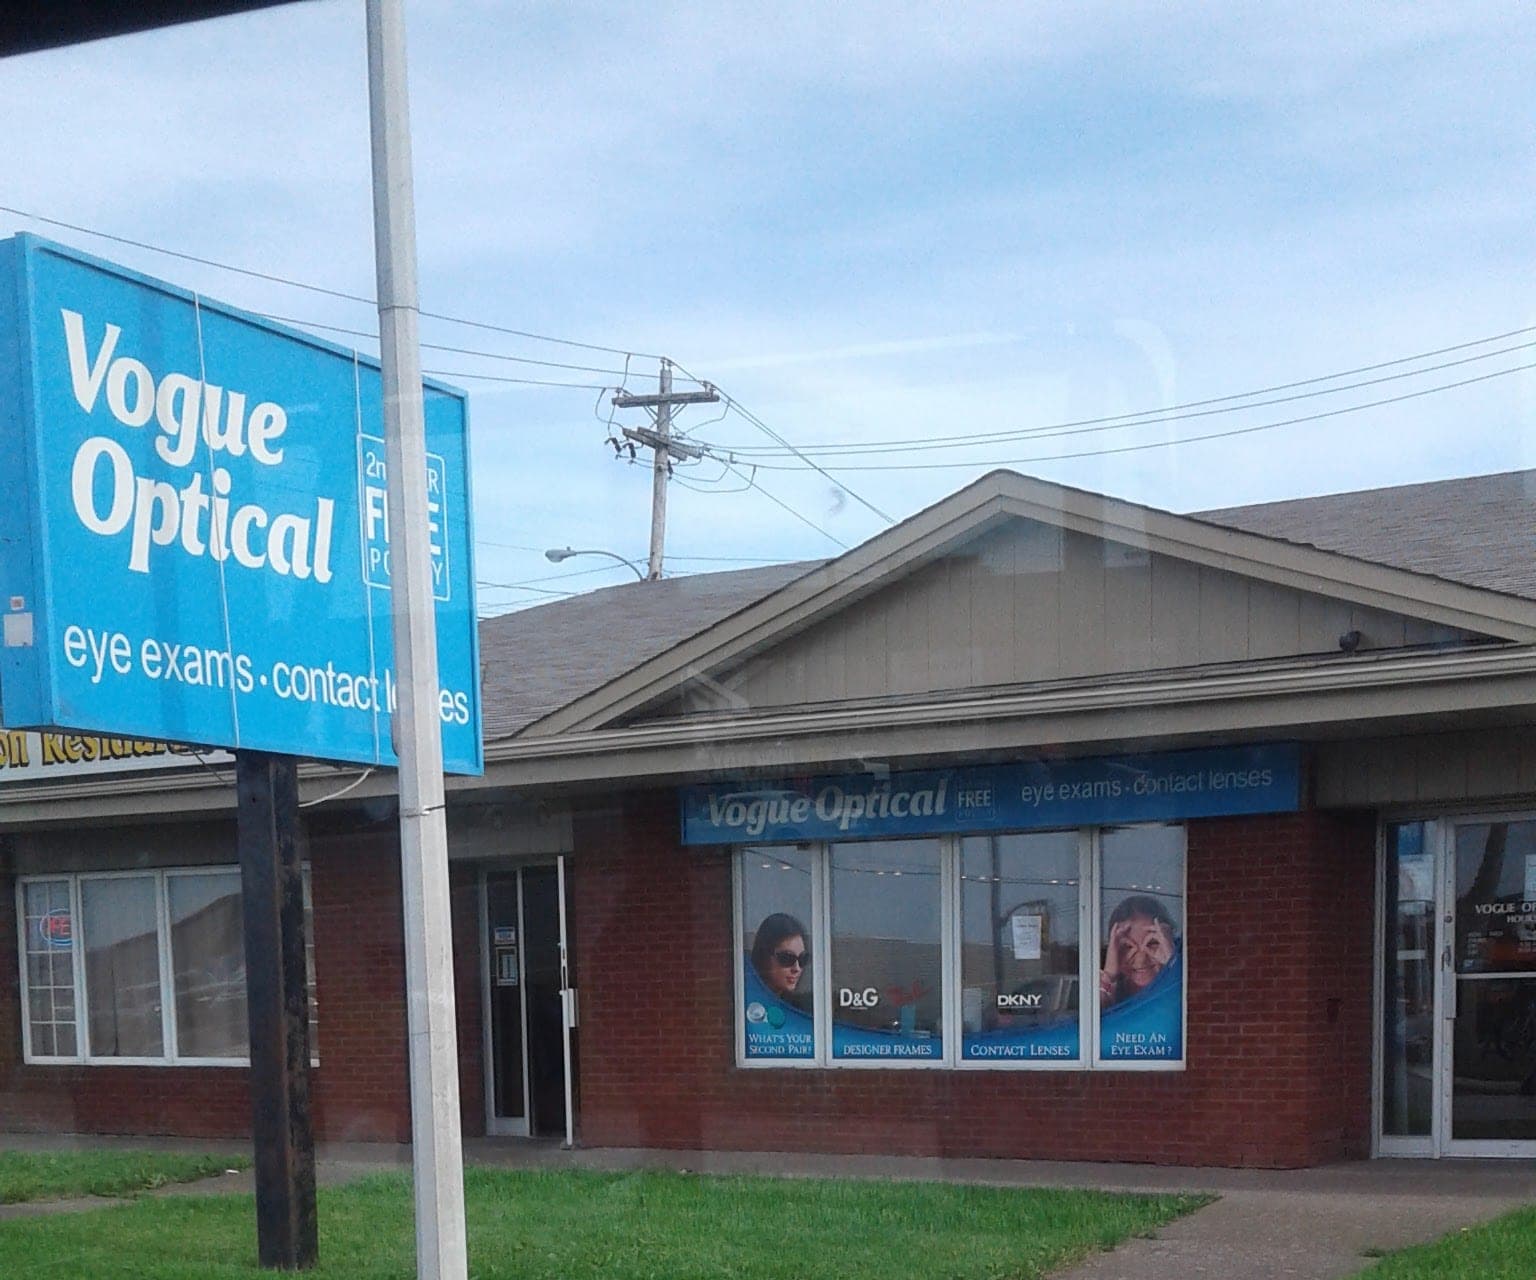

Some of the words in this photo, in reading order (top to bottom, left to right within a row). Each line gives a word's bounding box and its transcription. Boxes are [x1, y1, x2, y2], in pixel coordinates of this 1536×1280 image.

[61, 308, 288, 467] Vogue
[71, 436, 335, 584] Optical
[366, 486, 442, 555] FE
[63, 625, 132, 683] eye
[141, 638, 253, 693] exams
[273, 661, 380, 713] contact
[386, 668, 469, 725] les
[708, 792, 810, 836] Vogue
[815, 779, 949, 831] Optical
[957, 789, 992, 808] FREE
[1021, 783, 1052, 807] eye
[1059, 779, 1122, 801] exams
[1133, 772, 1202, 796] contact
[1208, 768, 1273, 790] lenses
[1475, 902, 1516, 914] VOGUE
[839, 987, 879, 1008] D&G
[997, 994, 1042, 1007] DKNY
[786, 1033, 812, 1044] YOUR
[1116, 1032, 1146, 1044] NEED
[1149, 1031, 1166, 1043] AN
[843, 1044, 892, 1056] DESIGNER
[893, 1044, 932, 1056] FRAMES
[970, 1044, 1026, 1056] CONTACT
[1030, 1044, 1070, 1056] LENSES
[1111, 1045, 1131, 1056] EYE
